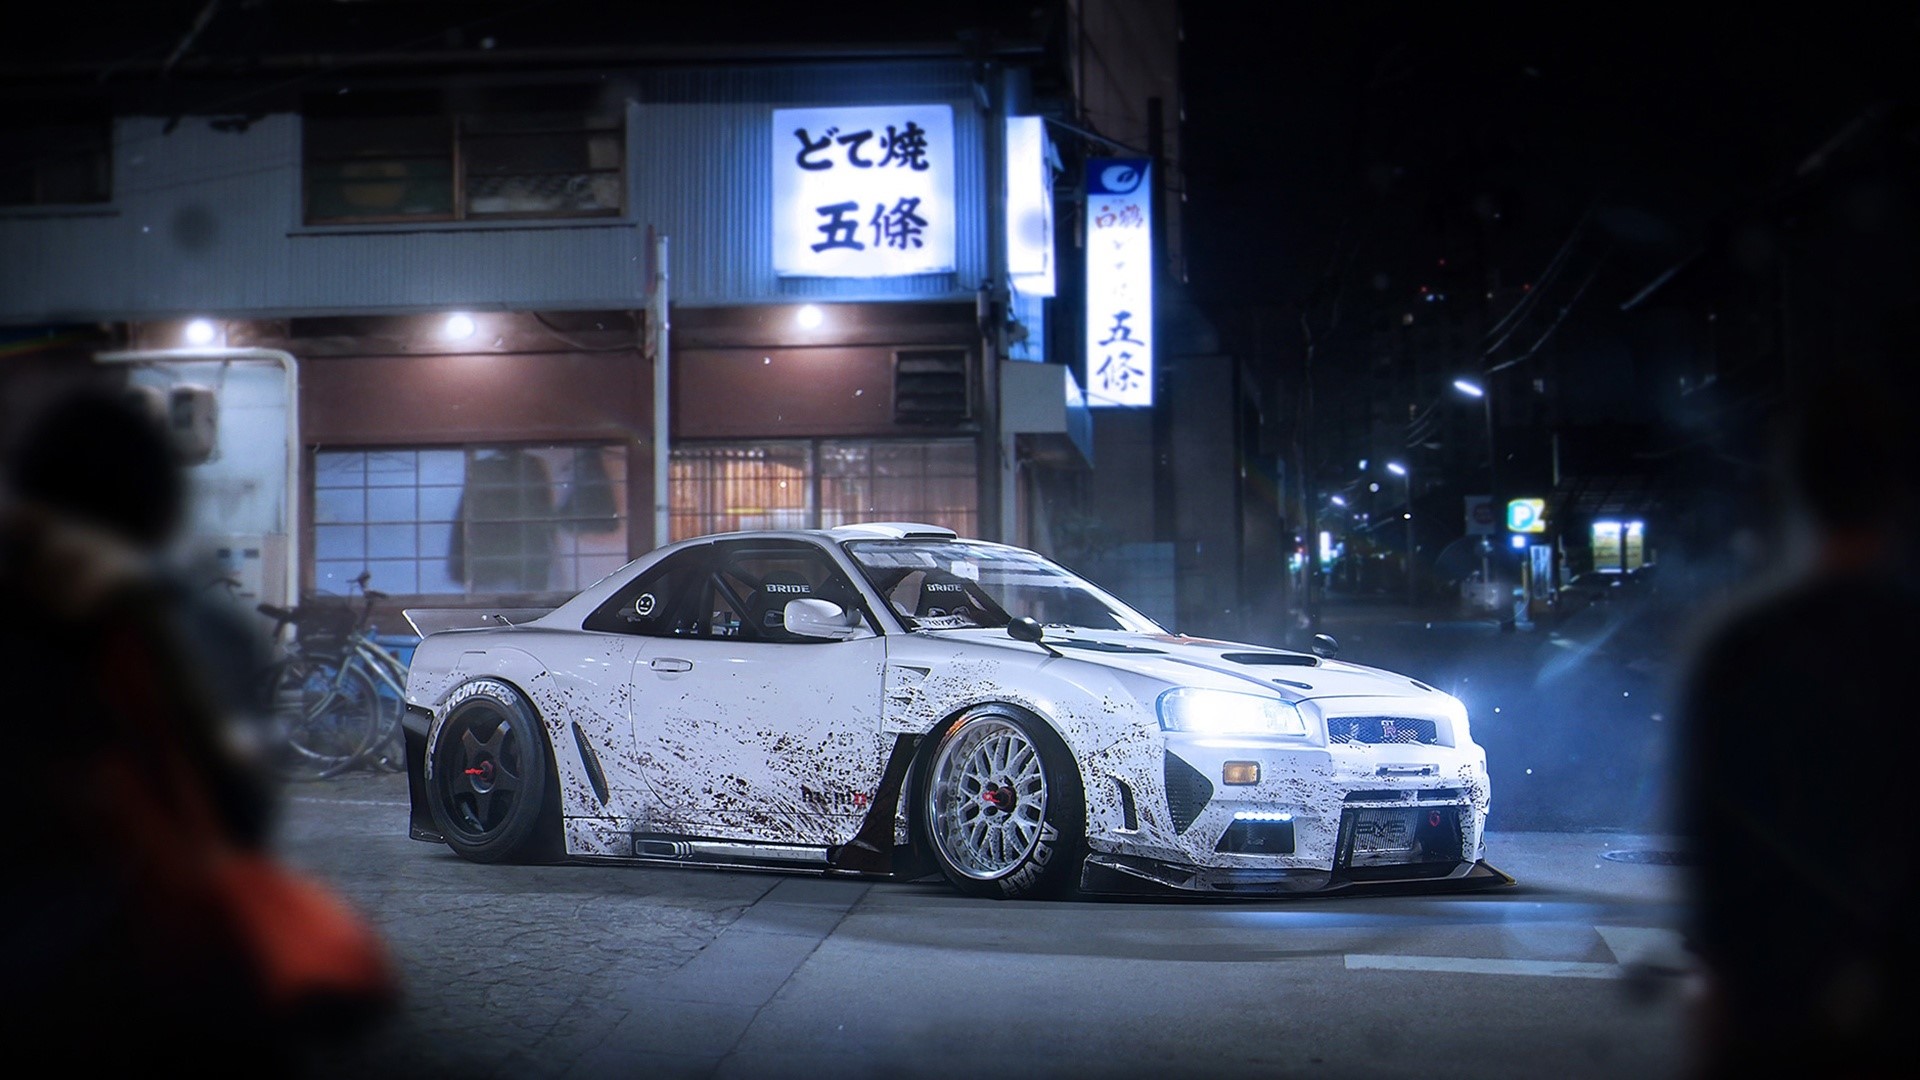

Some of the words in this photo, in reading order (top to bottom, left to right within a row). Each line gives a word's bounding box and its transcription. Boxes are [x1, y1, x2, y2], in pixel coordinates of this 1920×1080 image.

[794, 121, 930, 171] どて焼
[810, 197, 929, 253] 五條
[765, 584, 811, 593] BRIDE
[926, 583, 963, 592] BRIDE
[999, 821, 1059, 897] ADVAN
